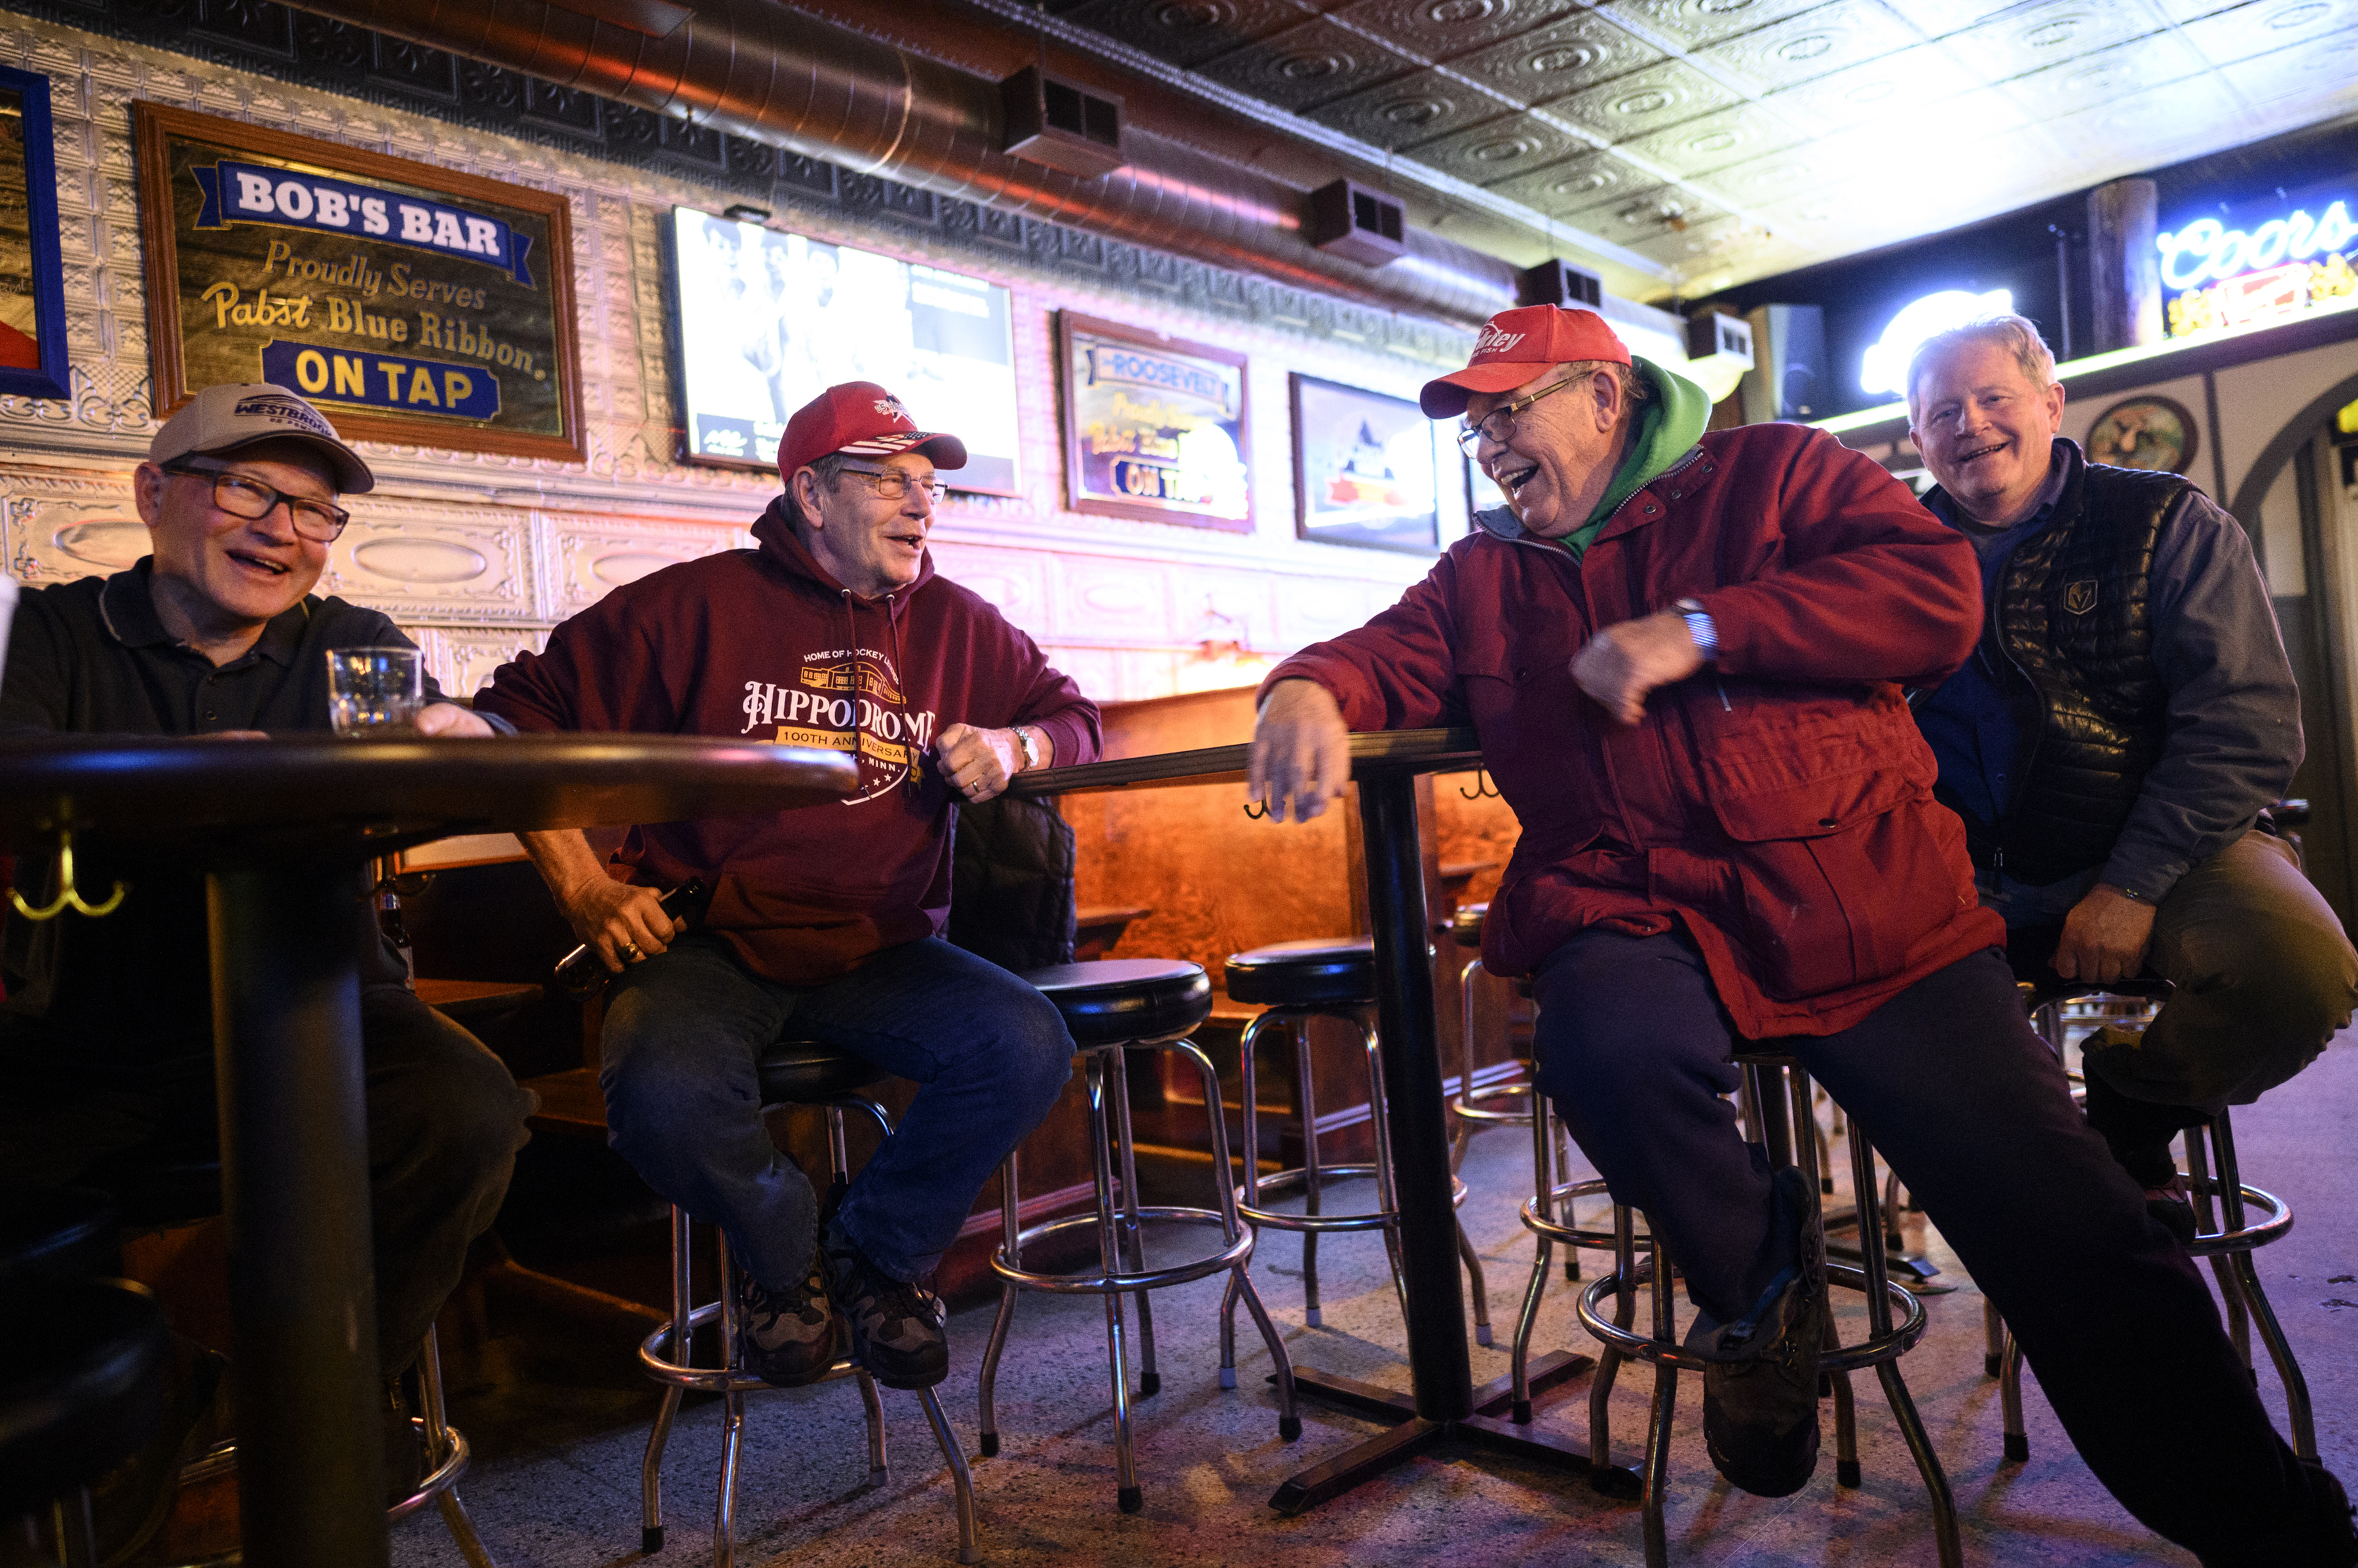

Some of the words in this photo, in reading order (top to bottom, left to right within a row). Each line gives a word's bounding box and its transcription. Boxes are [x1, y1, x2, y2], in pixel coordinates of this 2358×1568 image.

[236, 172, 390, 236] BOB'S
[399, 204, 500, 257] BAR
[2156, 200, 2358, 289] Coors
[262, 239, 383, 297] Proudly
[386, 263, 486, 310] Serves
[200, 281, 314, 329] Pabst
[326, 295, 407, 342] Blue
[1476, 329, 1526, 352] kley
[296, 349, 365, 398] ON
[377, 361, 473, 409] TAP
[804, 650, 831, 662] HOME
[832, 650, 845, 658] OF
[784, 732, 829, 745] 100TH
[869, 757, 901, 774] MINN.
